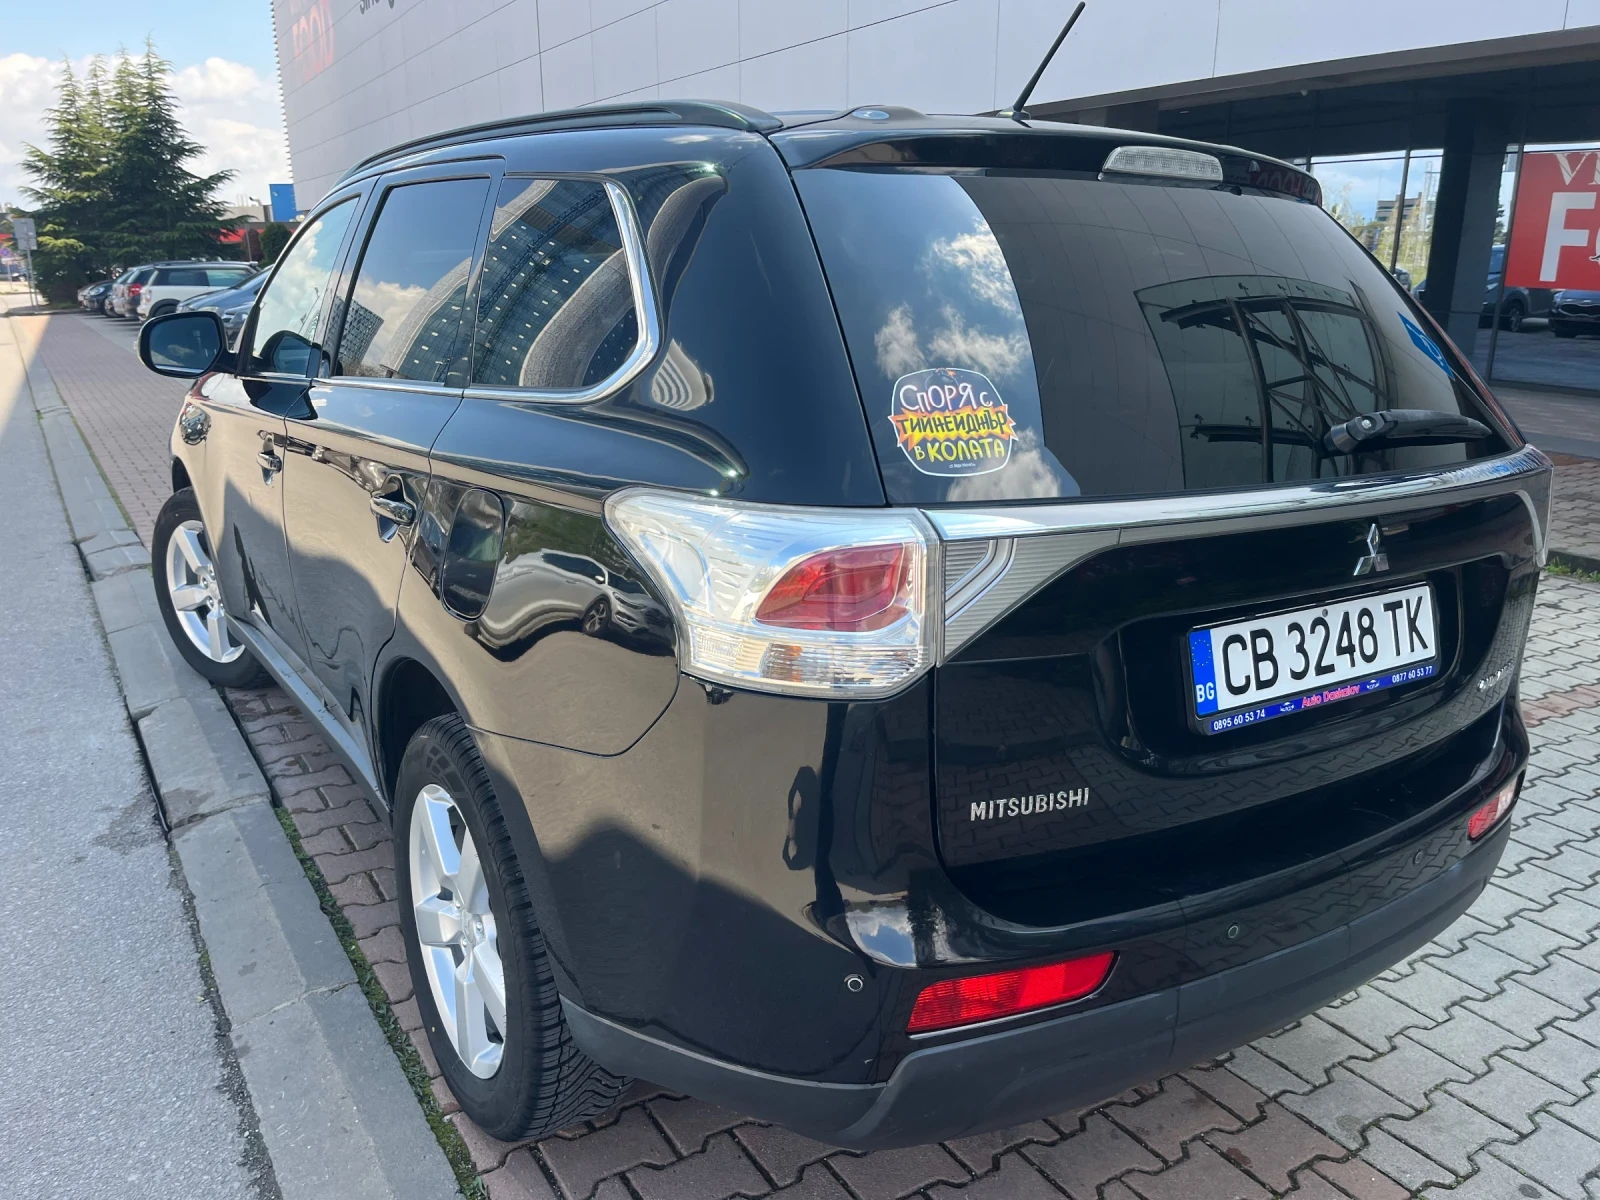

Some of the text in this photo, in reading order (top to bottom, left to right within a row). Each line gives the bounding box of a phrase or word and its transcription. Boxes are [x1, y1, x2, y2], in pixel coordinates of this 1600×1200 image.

[1539, 191, 1600, 283] F
[896, 410, 1007, 435] ТИЙНЕЙДЖЪР
[926, 438, 1005, 463] КОЛАТА
[1222, 595, 1429, 697] CB 3248 TK
[1195, 683, 1216, 704] BG
[1213, 665, 1433, 731] 0895 60 53 74 Auto Daskalov 0877 60 53 77
[970, 787, 1090, 821] MITSUBISHI
